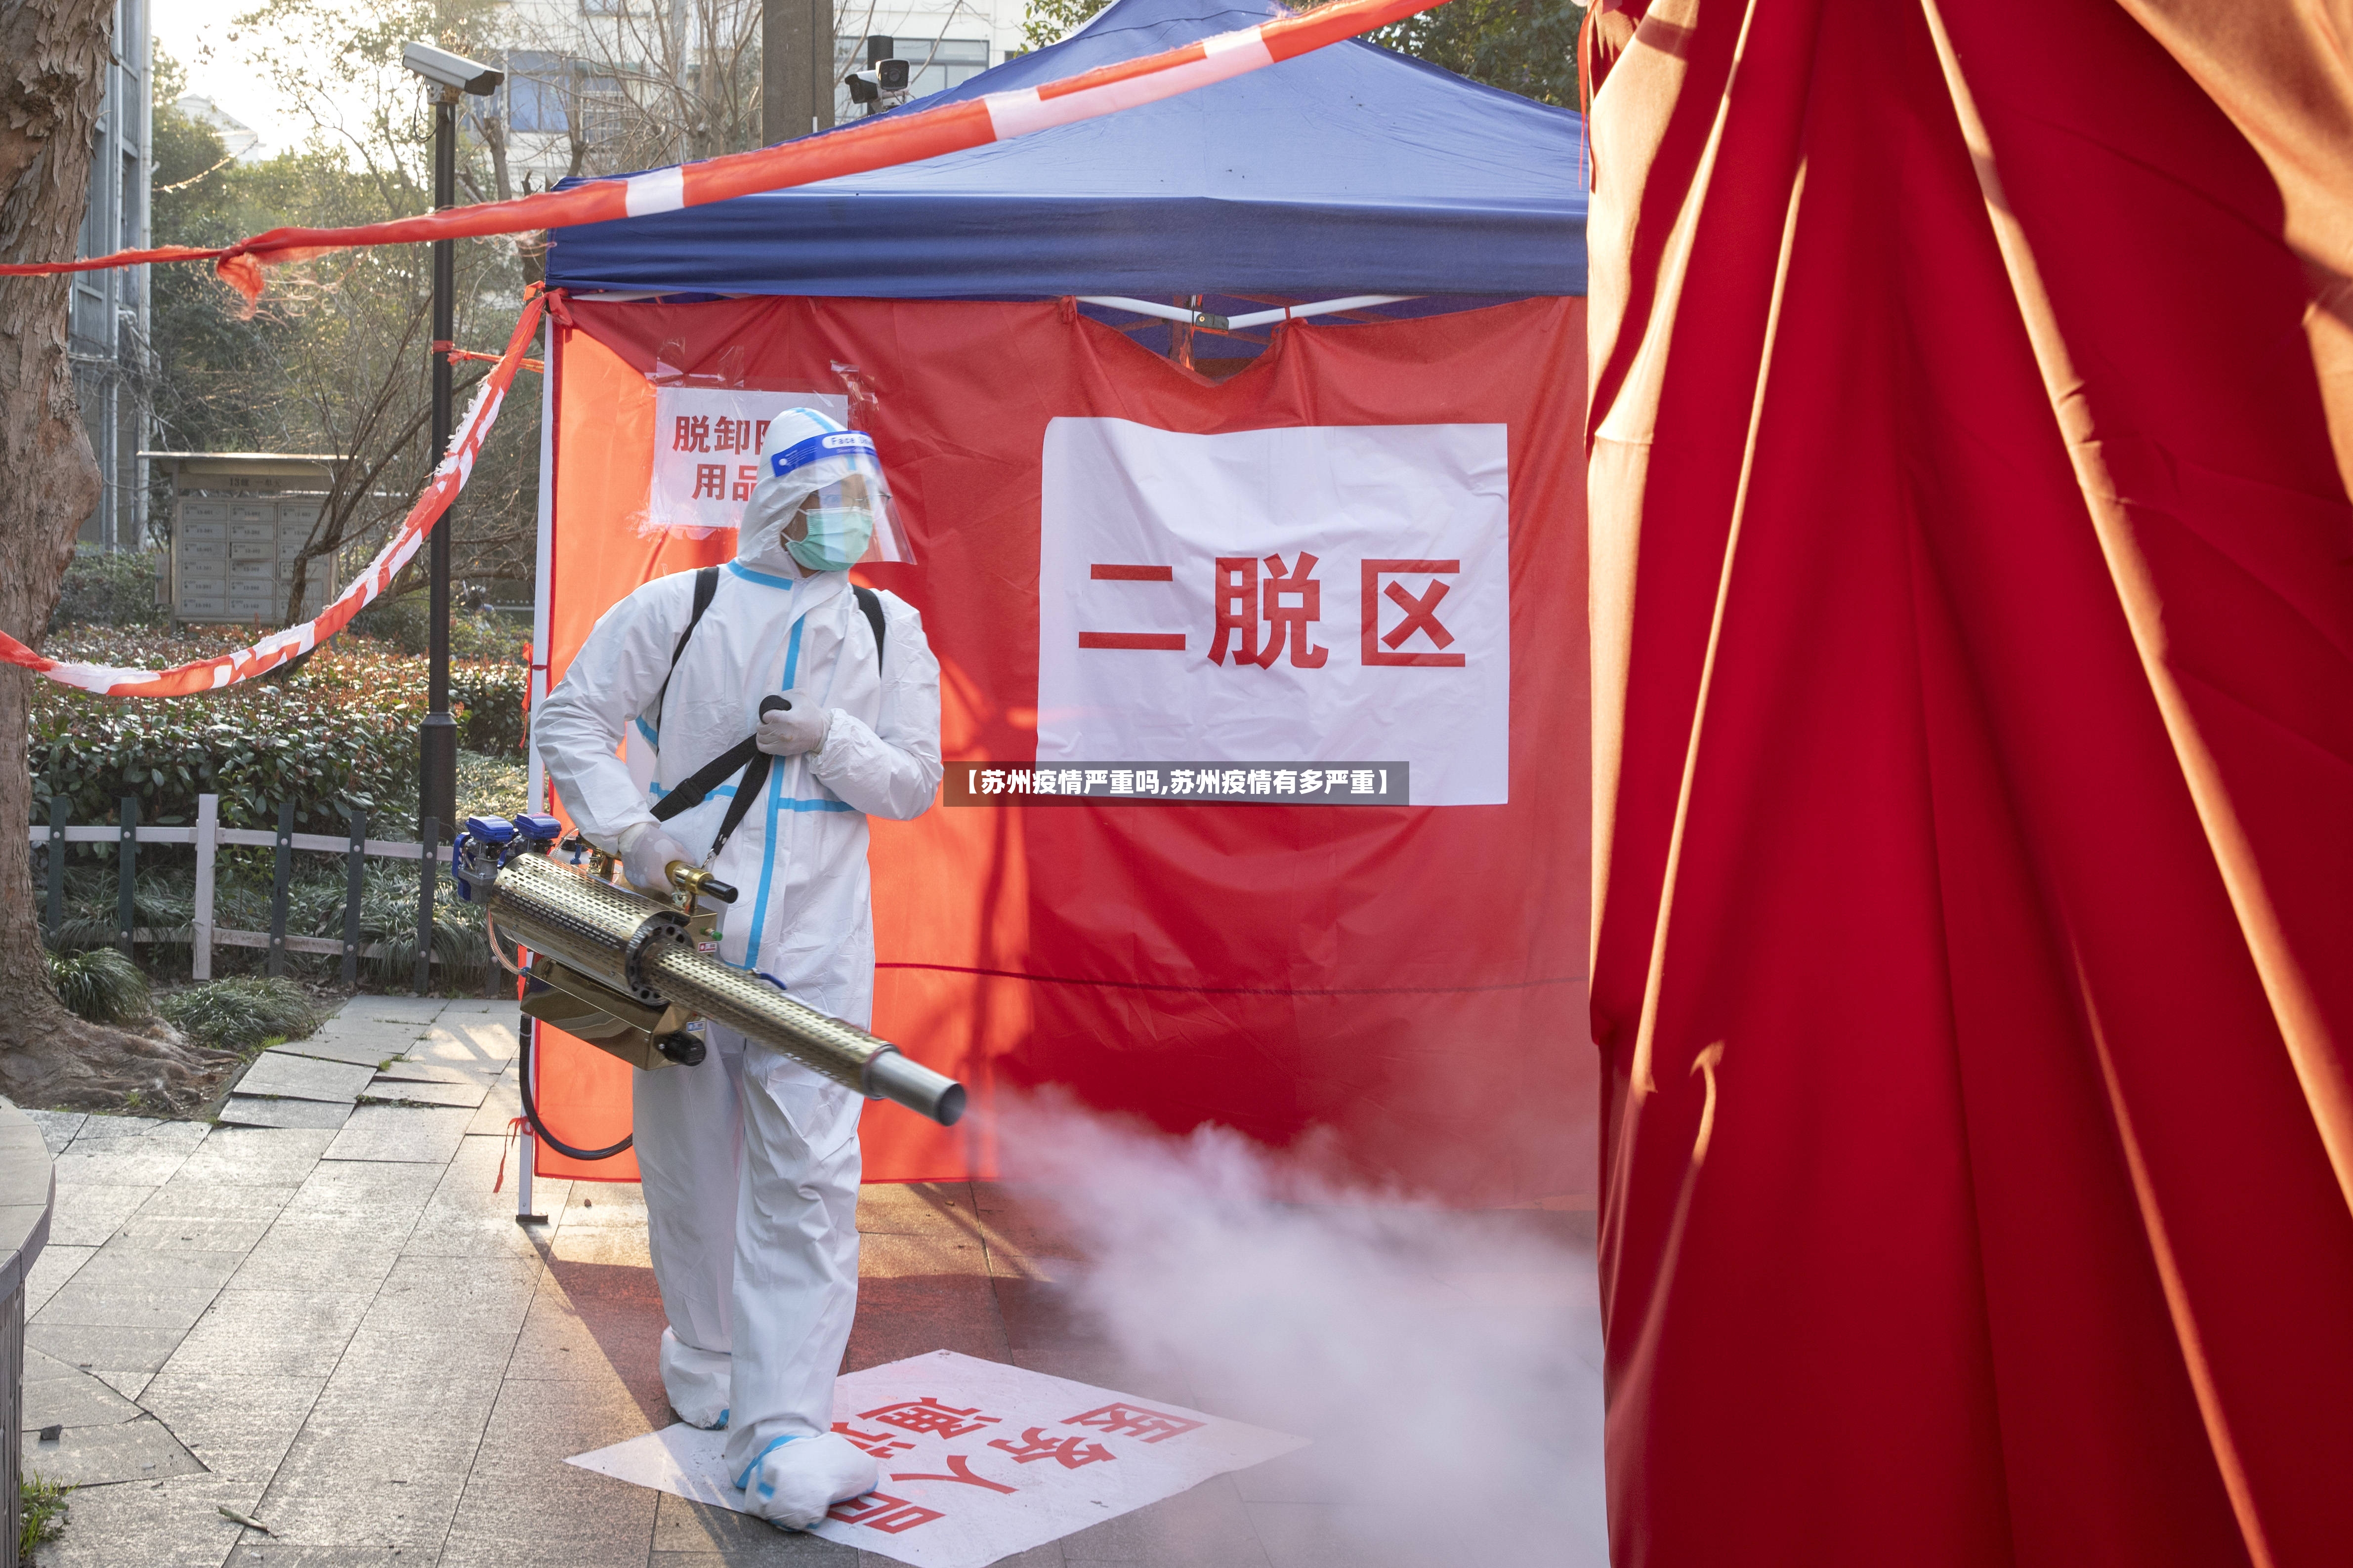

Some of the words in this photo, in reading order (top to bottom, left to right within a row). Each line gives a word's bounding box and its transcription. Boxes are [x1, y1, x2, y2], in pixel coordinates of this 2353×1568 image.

[1079, 551, 1466, 670] 二脱区
[827, 1402, 1207, 1534] 医务人员
